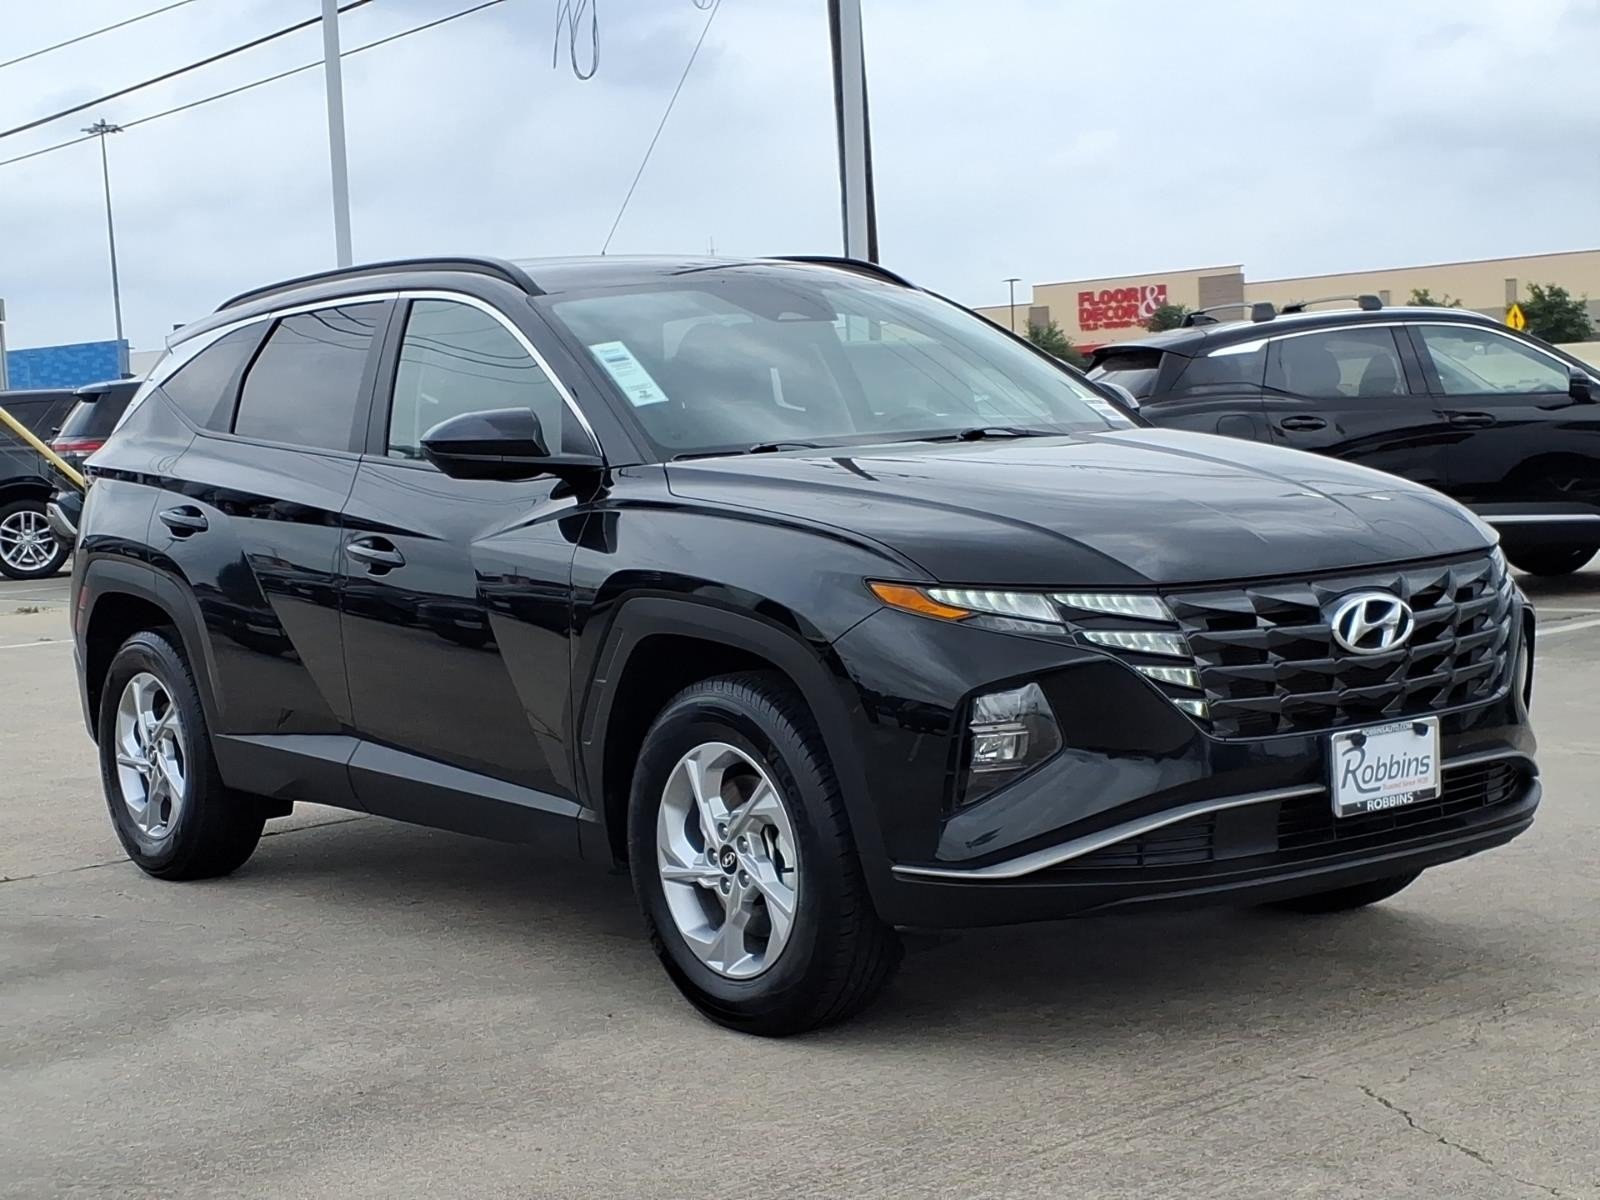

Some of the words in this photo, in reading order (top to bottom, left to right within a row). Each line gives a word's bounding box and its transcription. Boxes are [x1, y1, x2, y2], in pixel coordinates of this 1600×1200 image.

[1078, 288, 1139, 306] FLOOR
[1079, 304, 1139, 322] DECOR
[1341, 746, 1430, 794] Robbins
[1367, 792, 1414, 811] ROBBINS
